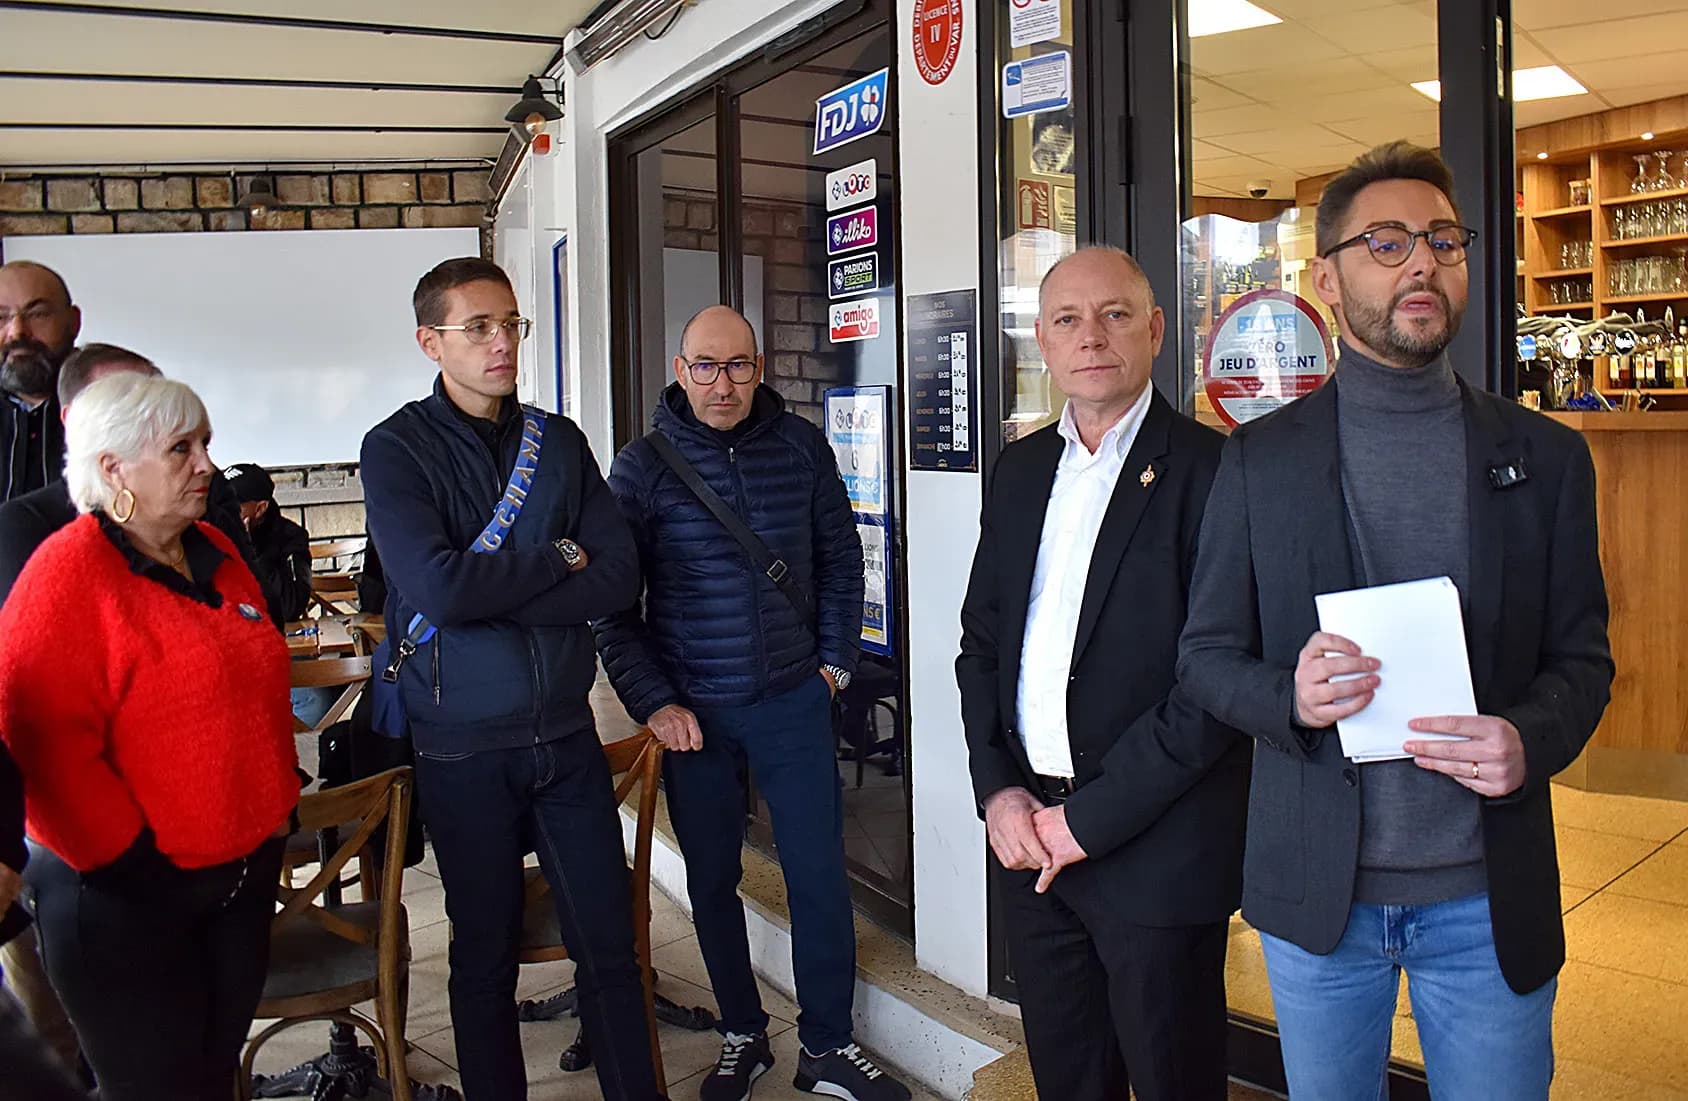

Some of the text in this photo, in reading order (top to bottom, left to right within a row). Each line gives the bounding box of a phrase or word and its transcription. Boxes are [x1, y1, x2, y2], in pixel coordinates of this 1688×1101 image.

[923, 4, 948, 22] LICENCE
[930, 23, 941, 43] IV
[950, 21, 961, 46] VAR
[948, 47, 957, 59] DU
[819, 93, 859, 142] FDJ
[843, 173, 872, 197] LOTO
[841, 217, 872, 244] illiko
[843, 260, 873, 276] PARIONS
[844, 272, 872, 286] SPORT
[843, 304, 874, 332] amigo
[1219, 355, 1317, 370] JEU D'ARGENT
